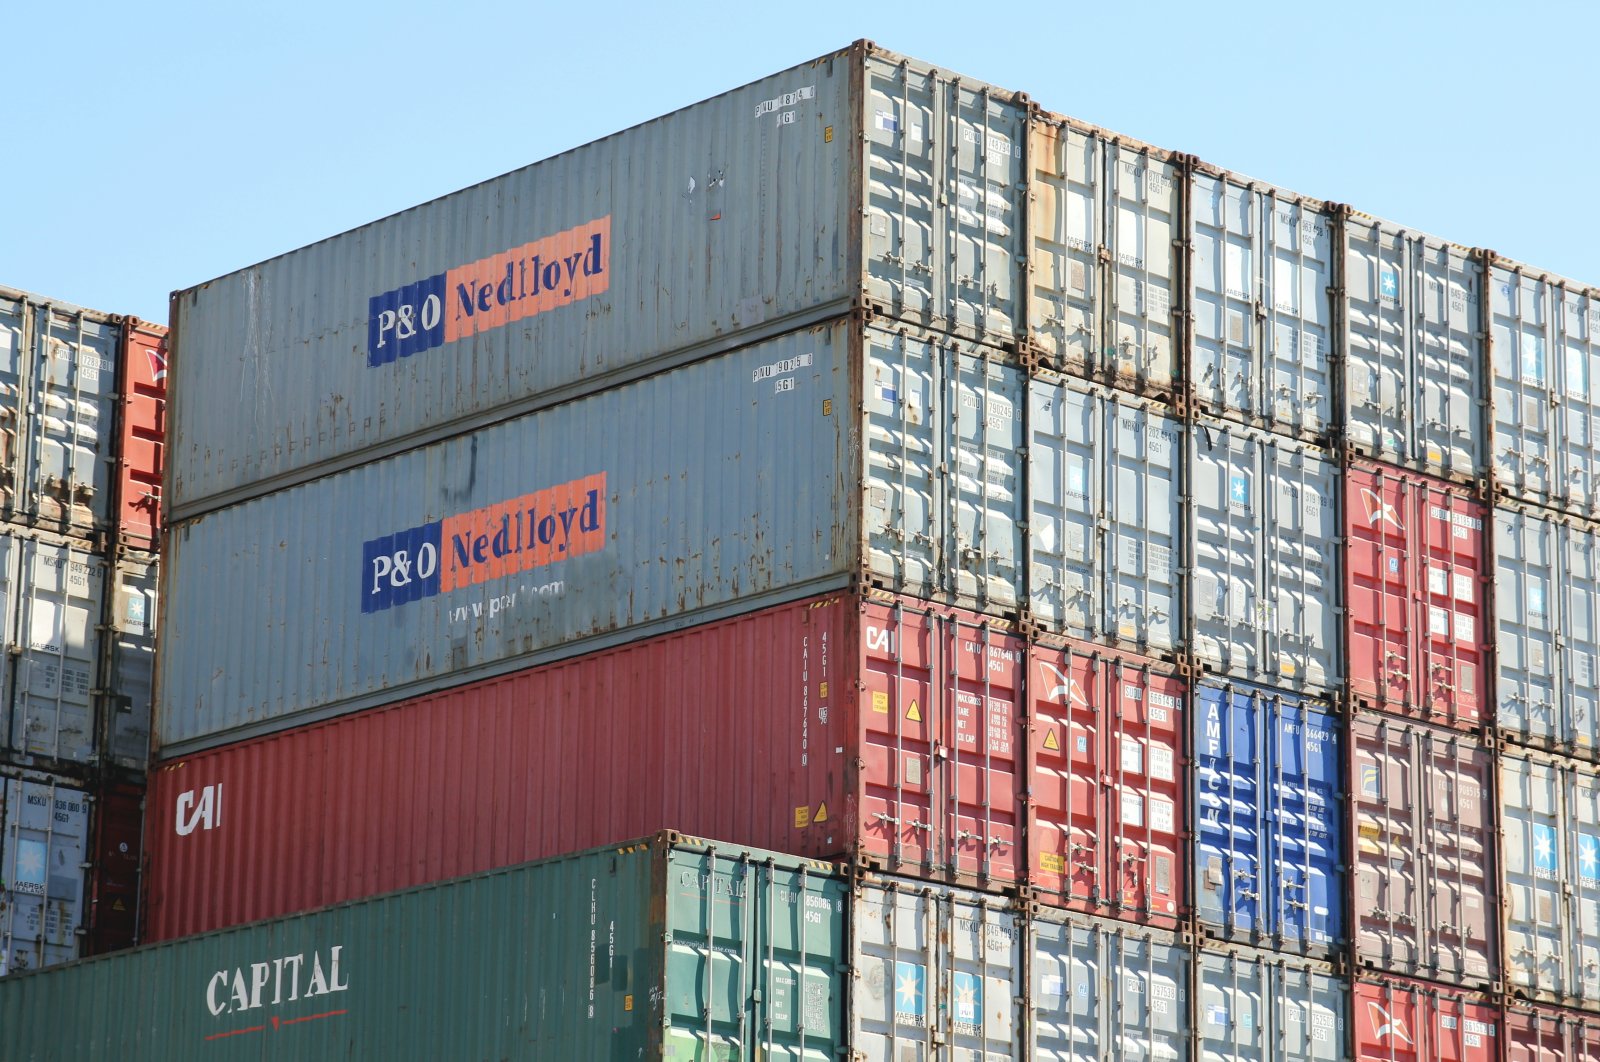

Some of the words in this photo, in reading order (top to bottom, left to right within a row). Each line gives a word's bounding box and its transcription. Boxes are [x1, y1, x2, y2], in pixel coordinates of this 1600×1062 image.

[1148, 182, 1163, 194] 45G1
[377, 294, 441, 349] P&O
[455, 232, 603, 322] Nedlloyd
[82, 368, 98, 380] 45G1
[963, 394, 980, 409] PONU
[989, 402, 1012, 418] 790245
[988, 417, 1003, 429] 45G1
[1122, 419, 1140, 432] MRKU
[1148, 427, 1159, 439] 202
[1148, 441, 1162, 453] 45G1
[1306, 506, 1319, 517] 45G1
[371, 541, 437, 595] P&O
[451, 488, 600, 572] Nedlloyd
[43, 556, 63, 569] MSKU
[70, 562, 82, 573] 949
[69, 574, 85, 586] 45G1
[965, 641, 982, 654] CAIU
[989, 646, 1013, 661] 867640
[988, 660, 1004, 673] 45G1
[1125, 686, 1142, 700] SUDU
[1151, 708, 1167, 721] 45G1
[1284, 723, 1300, 735] AMFU
[1307, 741, 1322, 753] 45G1
[27, 794, 47, 807] MSKU
[54, 800, 67, 810] 836
[175, 782, 223, 836] CAI
[54, 811, 69, 823] 45G1
[15, 880, 44, 891] MAERSK
[680, 871, 745, 898] CAPTAL
[805, 895, 831, 910] 856086
[805, 910, 821, 924] 45G1
[960, 920, 978, 934] MSKU
[986, 925, 999, 937] 846
[986, 939, 1003, 952] 45G1
[206, 945, 350, 1017] CAPITAL
[1152, 1000, 1168, 1013] 45G1
[1311, 1028, 1328, 1040] 45G1
